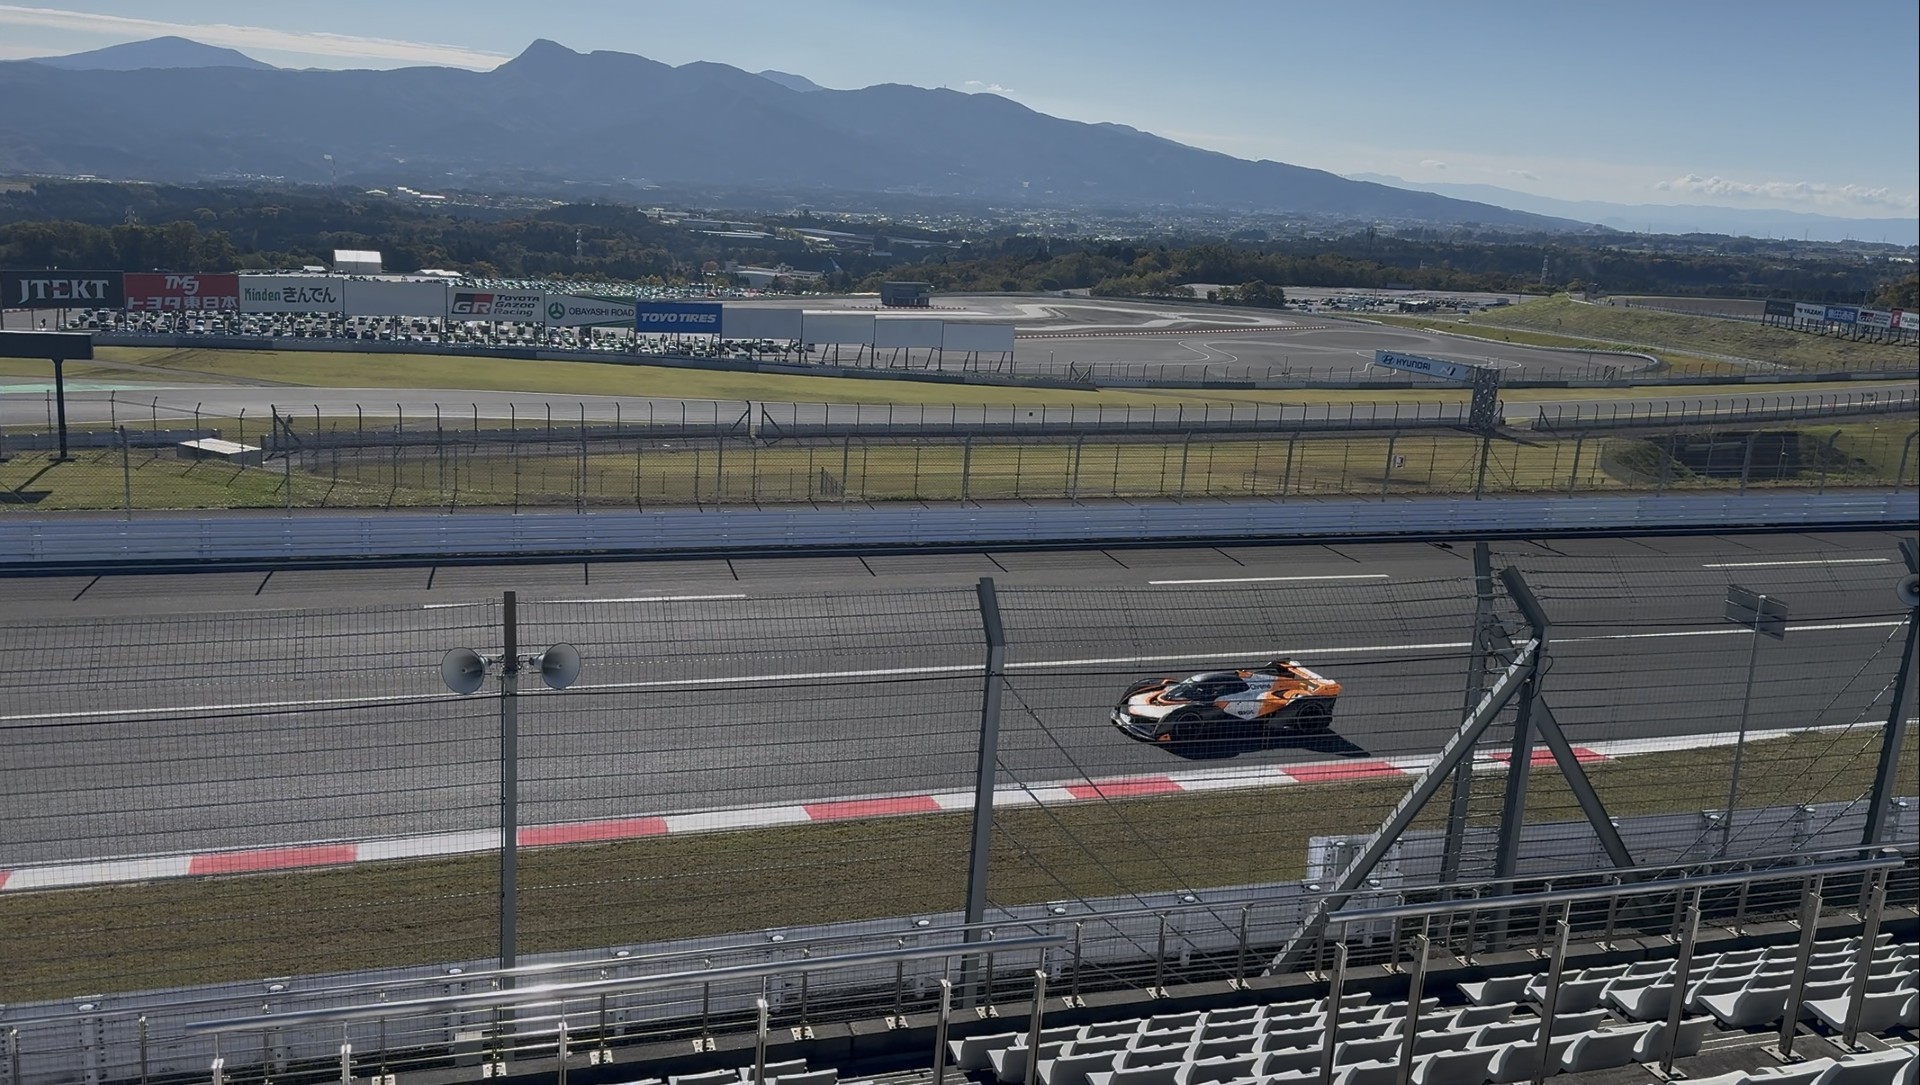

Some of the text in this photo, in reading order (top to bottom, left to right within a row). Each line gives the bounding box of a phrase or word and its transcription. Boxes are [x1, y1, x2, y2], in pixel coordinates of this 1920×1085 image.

[18, 279, 110, 304] JTEKT
[244, 286, 337, 304] Kinden きんでん
[127, 296, 238, 309] トヨタ東日本
[496, 294, 540, 302] TOYOTA
[453, 301, 491, 314] GR
[495, 301, 535, 309] GAZOO
[494, 308, 533, 317] Racing
[568, 307, 635, 317] OBAYASHI ROAD
[641, 313, 717, 323] TOYO TIRES
[1396, 358, 1431, 371] HYUNDAI
